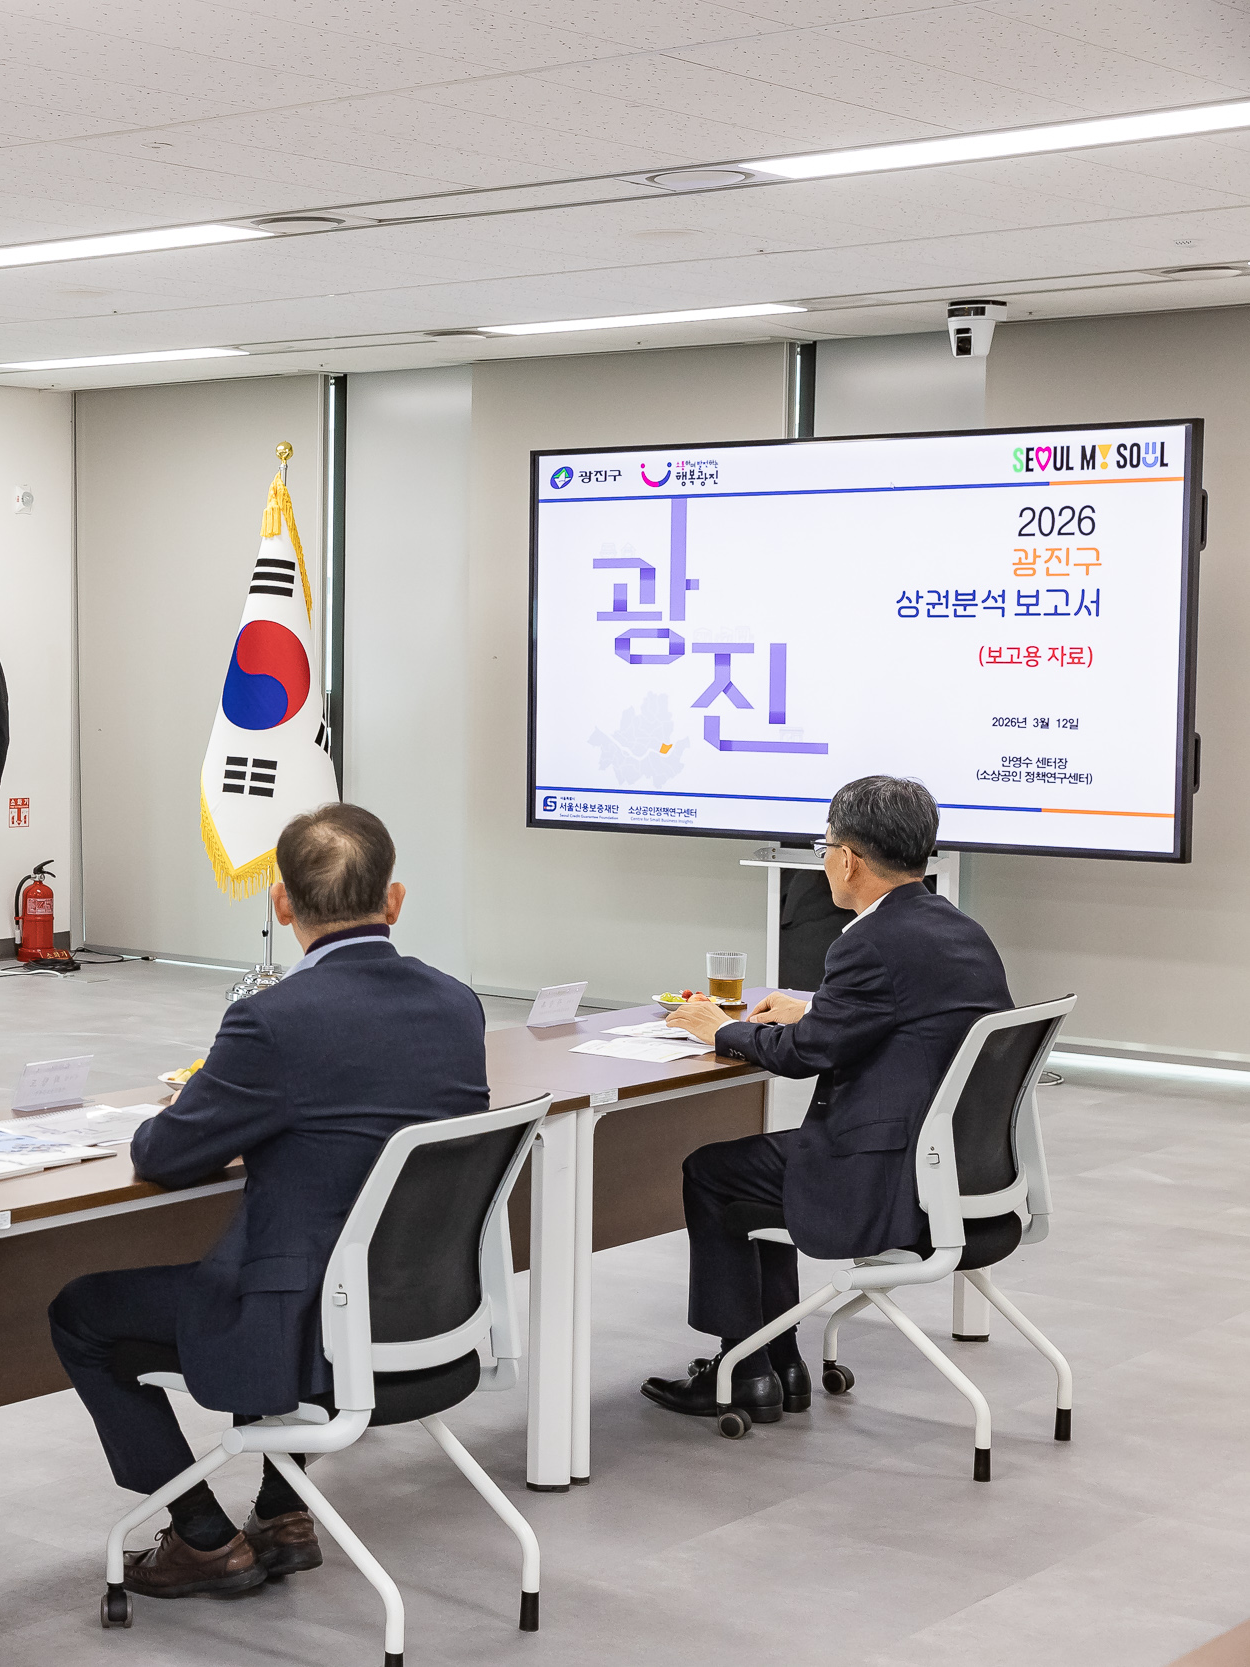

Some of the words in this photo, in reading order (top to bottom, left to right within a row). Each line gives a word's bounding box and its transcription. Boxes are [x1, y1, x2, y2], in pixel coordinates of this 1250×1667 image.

[1012, 445, 1074, 473] SEOUL
[1116, 441, 1169, 469] SOUL
[578, 469, 623, 484] 광진구
[675, 469, 719, 487] 행복광진
[1017, 505, 1096, 537] 2026
[1012, 547, 1103, 577] 광진구
[896, 589, 1006, 618] 상권분석
[1014, 588, 1101, 618] 보고서
[978, 645, 1042, 668] (보고용
[1047, 645, 1094, 668] 자료)
[992, 716, 1027, 729] 2026년
[1032, 717, 1050, 730] 3월
[1055, 718, 1079, 730] 12일
[1001, 756, 1033, 769] 안영수
[1035, 757, 1068, 770] 센터장
[976, 769, 1022, 783] (소상공인
[1024, 771, 1093, 785] 정책연구센터)
[559, 802, 620, 814] 서울신용보증재단
[628, 806, 698, 818] 소상공인정책연구센터
[46, 950, 69, 960] 소화기
